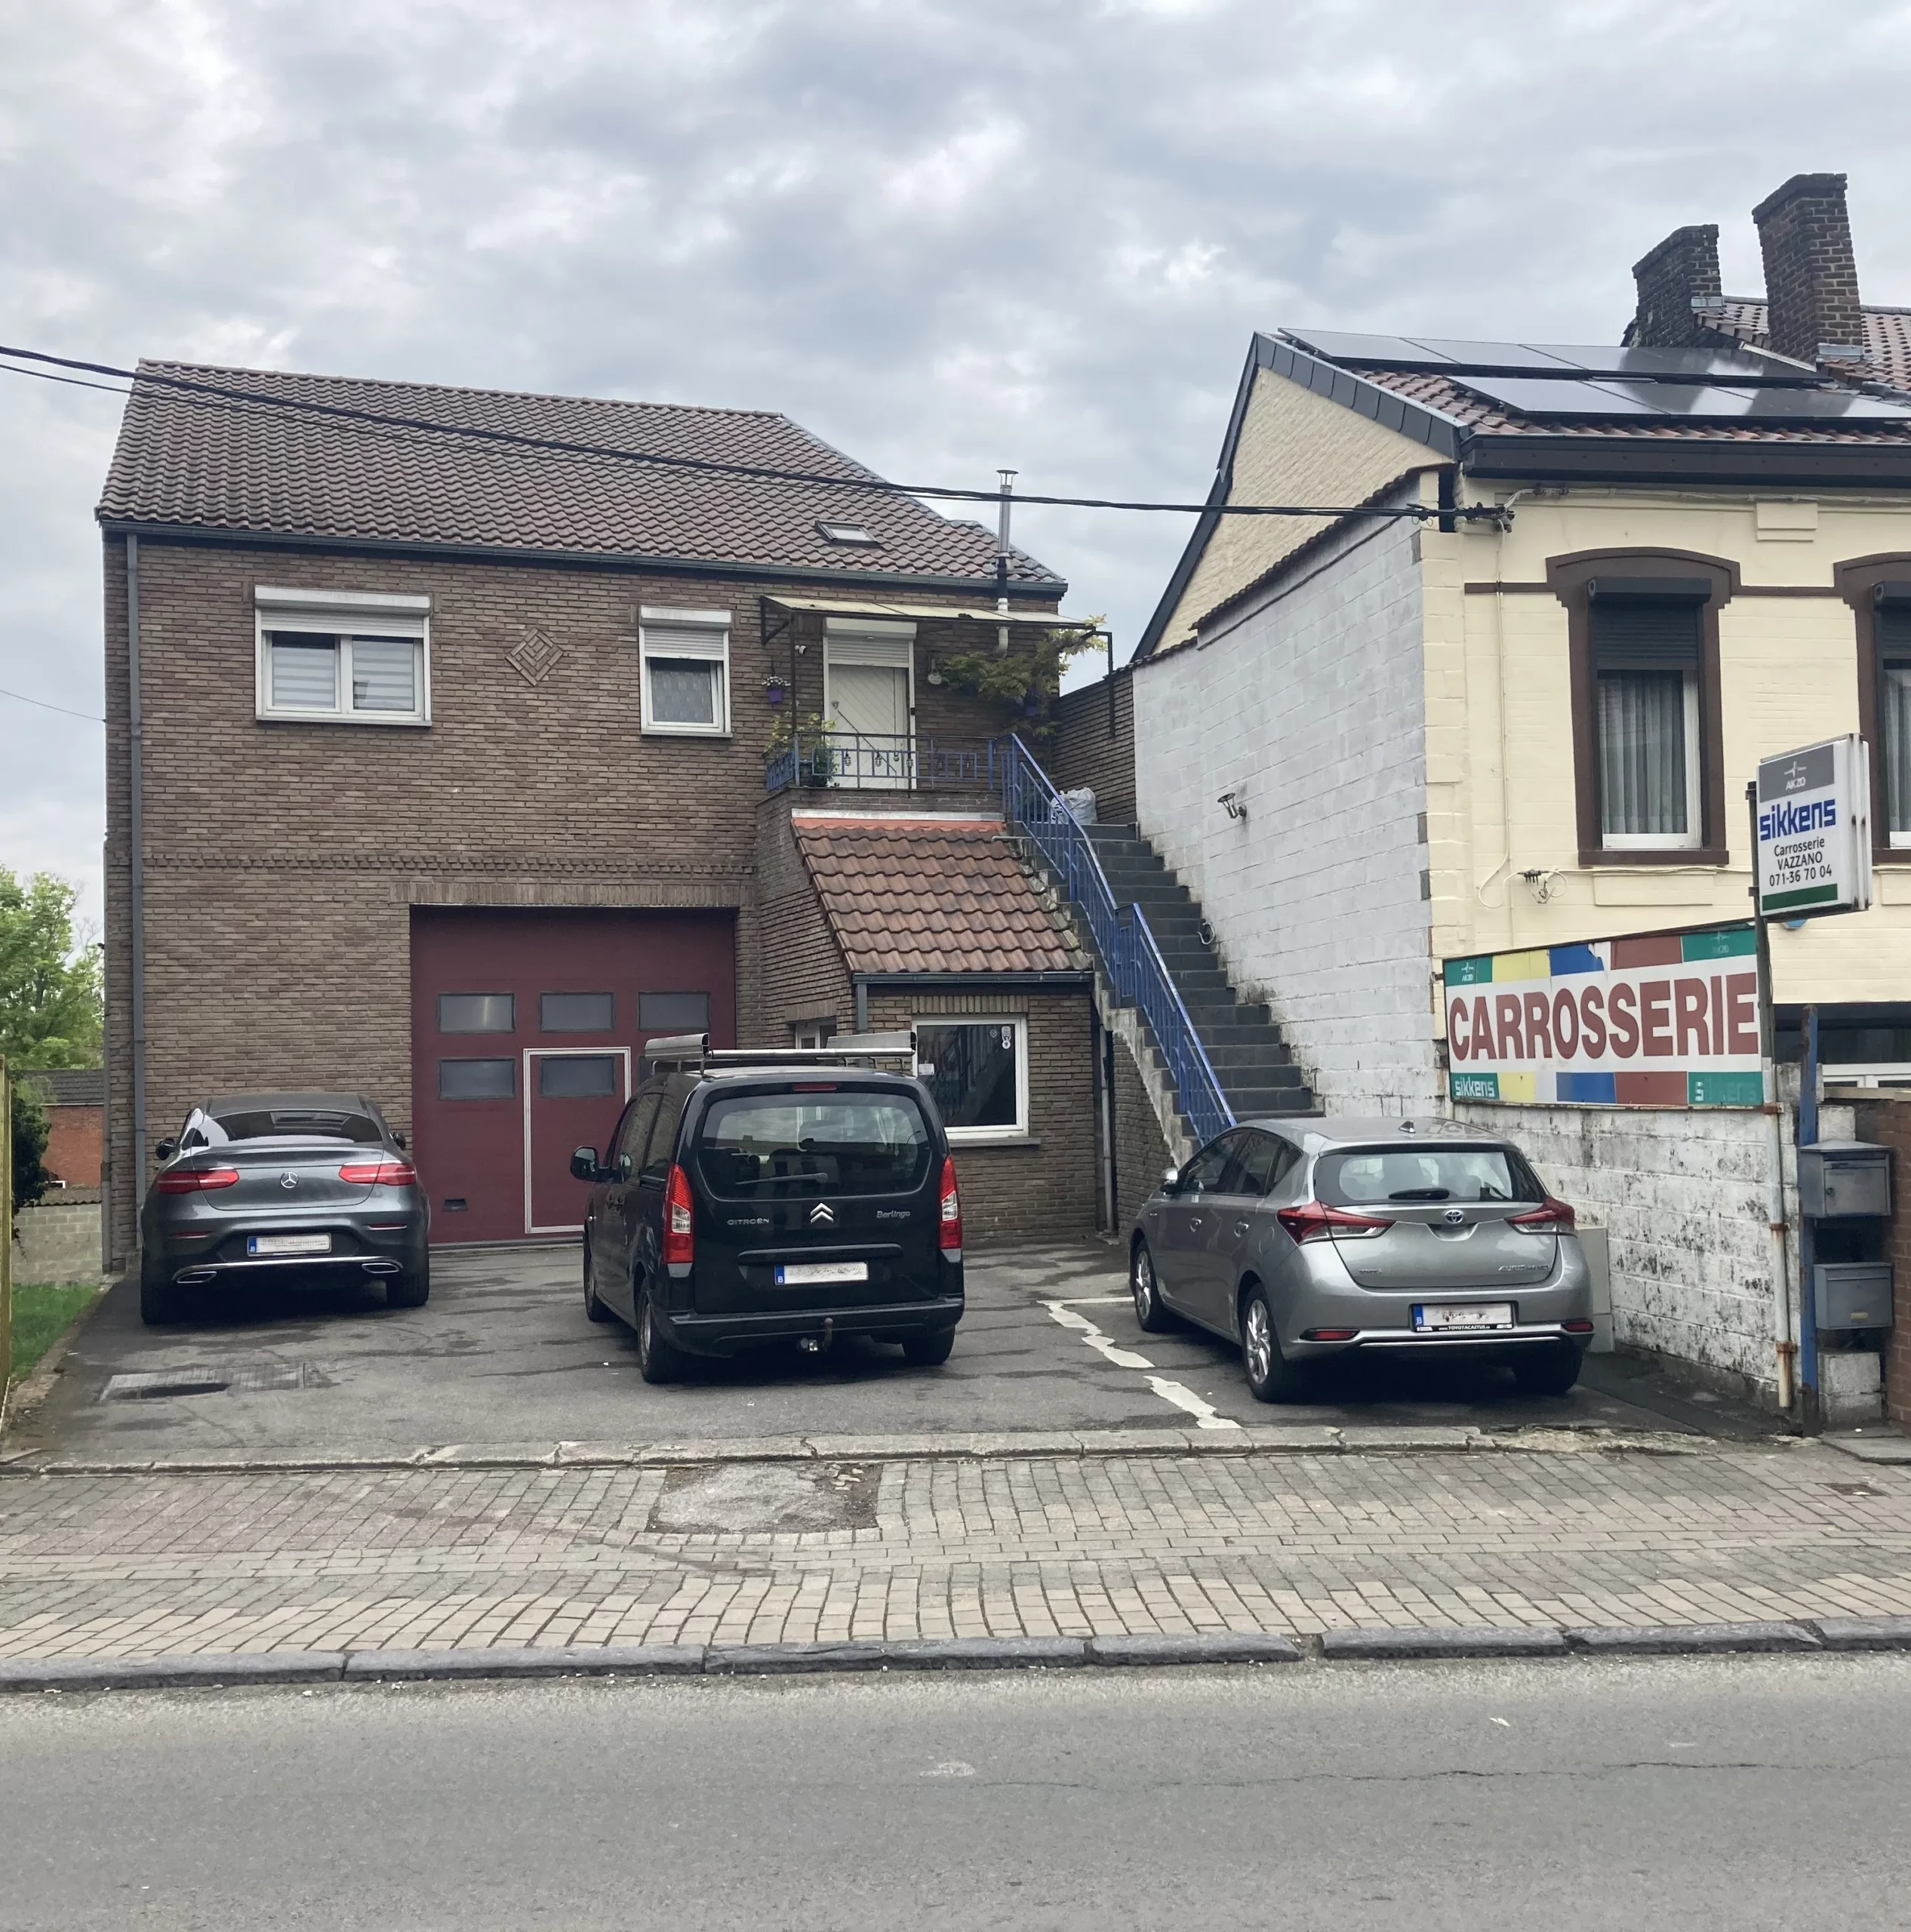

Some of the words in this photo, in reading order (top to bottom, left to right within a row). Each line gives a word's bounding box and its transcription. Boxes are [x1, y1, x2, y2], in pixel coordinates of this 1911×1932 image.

[1760, 798, 1836, 841] sikkens
[1774, 835, 1825, 857] Carrosserie
[1777, 851, 1823, 871] VAZZANO
[1769, 869, 1801, 887] 071-36
[1804, 867, 1816, 880] 70
[1820, 864, 1832, 878] 04
[1449, 972, 1759, 1061] CARROSSERIE
[1454, 1075, 1495, 1097] sikkens
[876, 1210, 911, 1219] Berlingo
